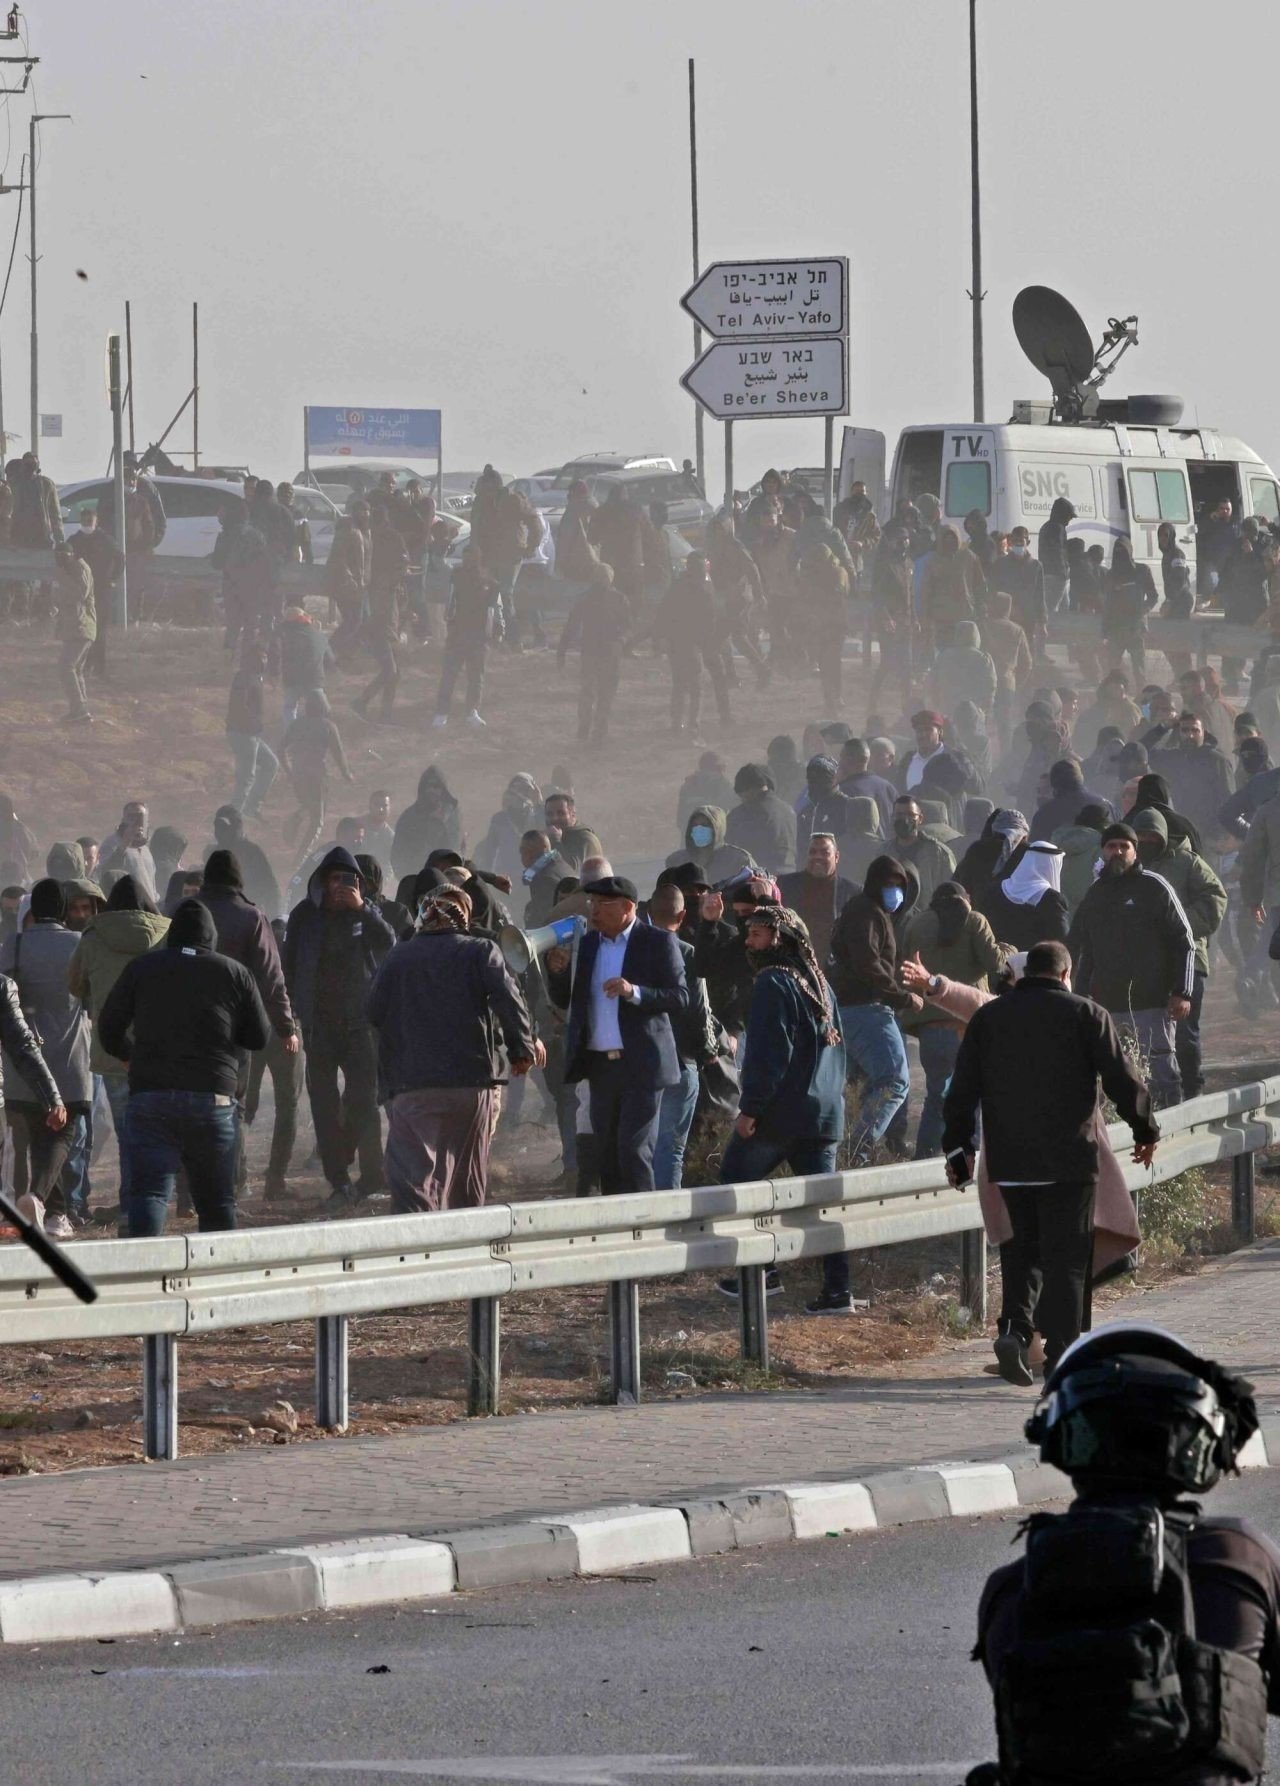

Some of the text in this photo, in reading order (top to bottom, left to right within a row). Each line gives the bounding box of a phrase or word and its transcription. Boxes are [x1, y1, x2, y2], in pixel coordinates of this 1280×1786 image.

[723, 269, 827, 287] תל אביב-יפו
[803, 289, 820, 306] تل
[716, 311, 832, 328] Tel Aviv-Yafo
[738, 350, 814, 365] באר שבע
[723, 390, 829, 406] Be'er Sheva
[951, 435, 989, 457] TV HD
[1022, 469, 1070, 498] SNG
[1023, 500, 1093, 513] Broadc rvice
